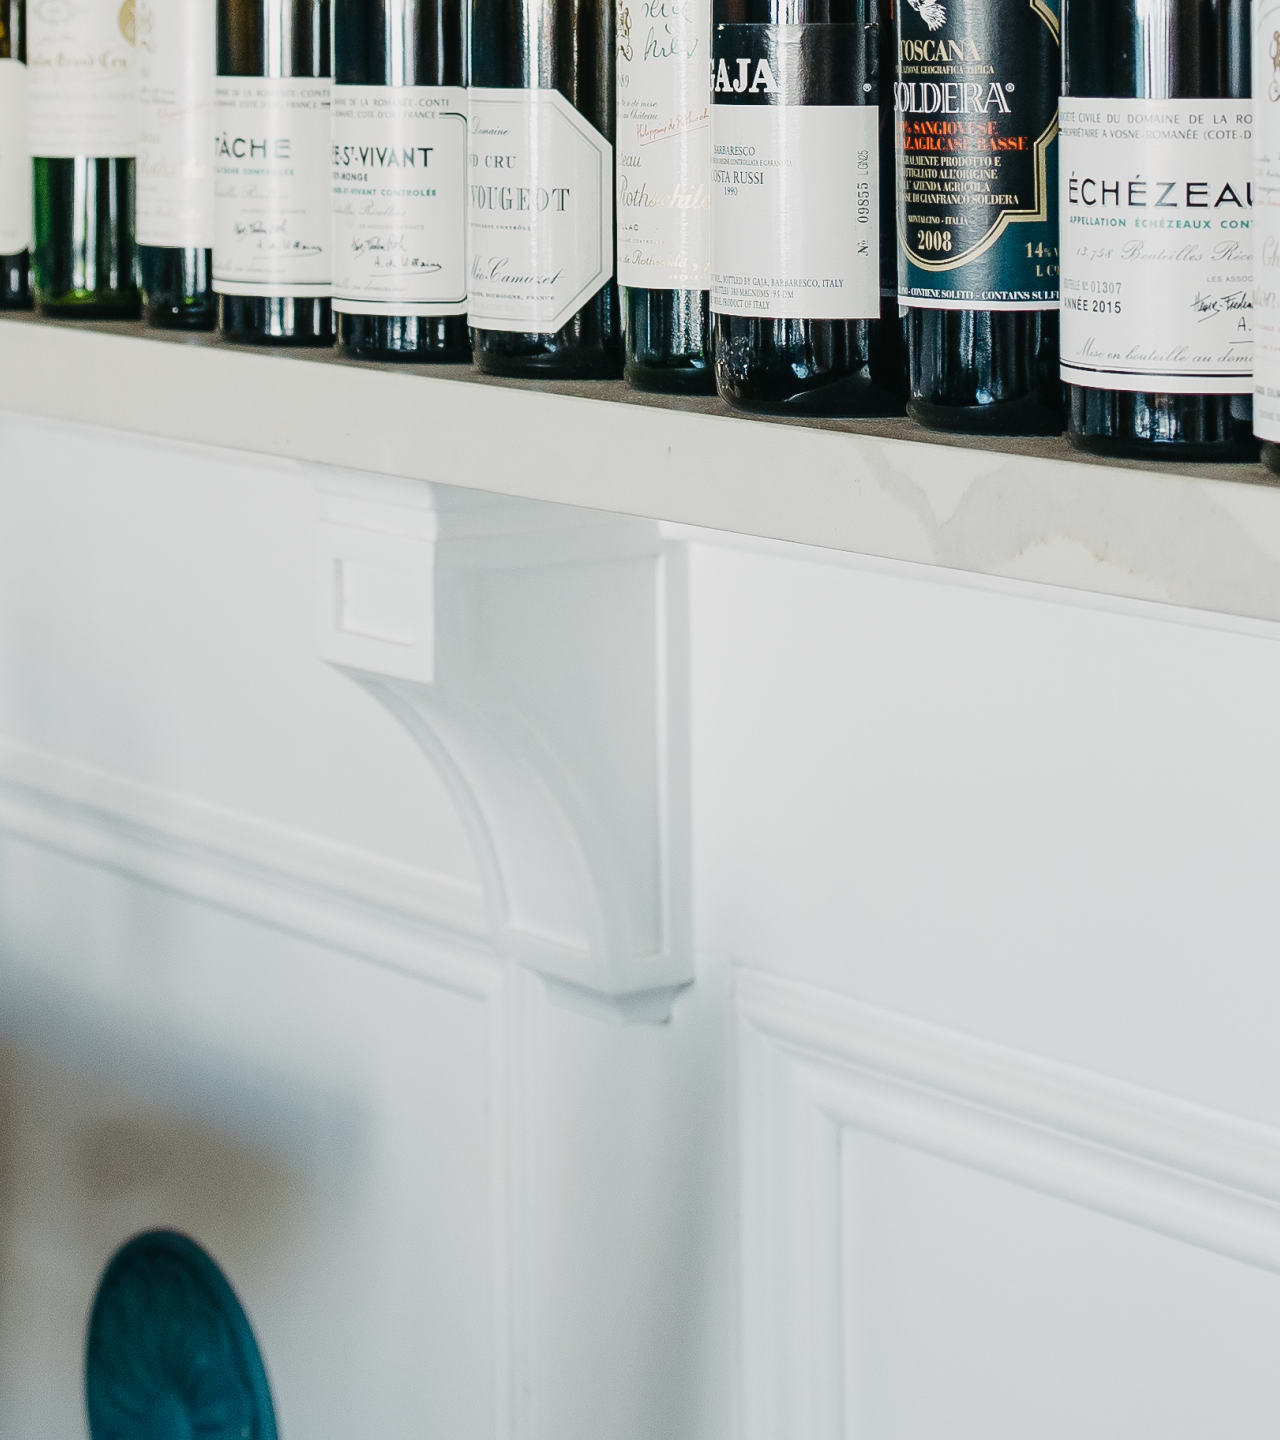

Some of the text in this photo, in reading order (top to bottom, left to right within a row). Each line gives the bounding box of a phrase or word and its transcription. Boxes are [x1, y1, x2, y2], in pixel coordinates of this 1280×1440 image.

[900, 39, 981, 62] TOSCANA
[1078, 112, 1102, 123] CIVILE
[1106, 113, 1121, 124] DU
[1188, 114, 1205, 125] DE
[1213, 114, 1228, 125] LA
[1235, 113, 1254, 125] RO
[484, 154, 518, 169] CRU
[712, 170, 764, 185] OSTA RUSSI
[1068, 170, 1253, 208] ÉCHÉZEAU
[471, 184, 571, 212] VOUGEOT
[856, 182, 870, 225] 09855
[971, 193, 1020, 205] SOLDERA
[1070, 215, 1127, 227] APPELLATION
[1220, 219, 1253, 229] CON
[916, 229, 953, 252] 2008
[822, 279, 844, 288] ITALY
[1089, 280, 1122, 295] 01307
[1225, 275, 1254, 283] ASSOC
[981, 290, 1031, 300] CONTAINS
[1092, 299, 1122, 314] 2015
